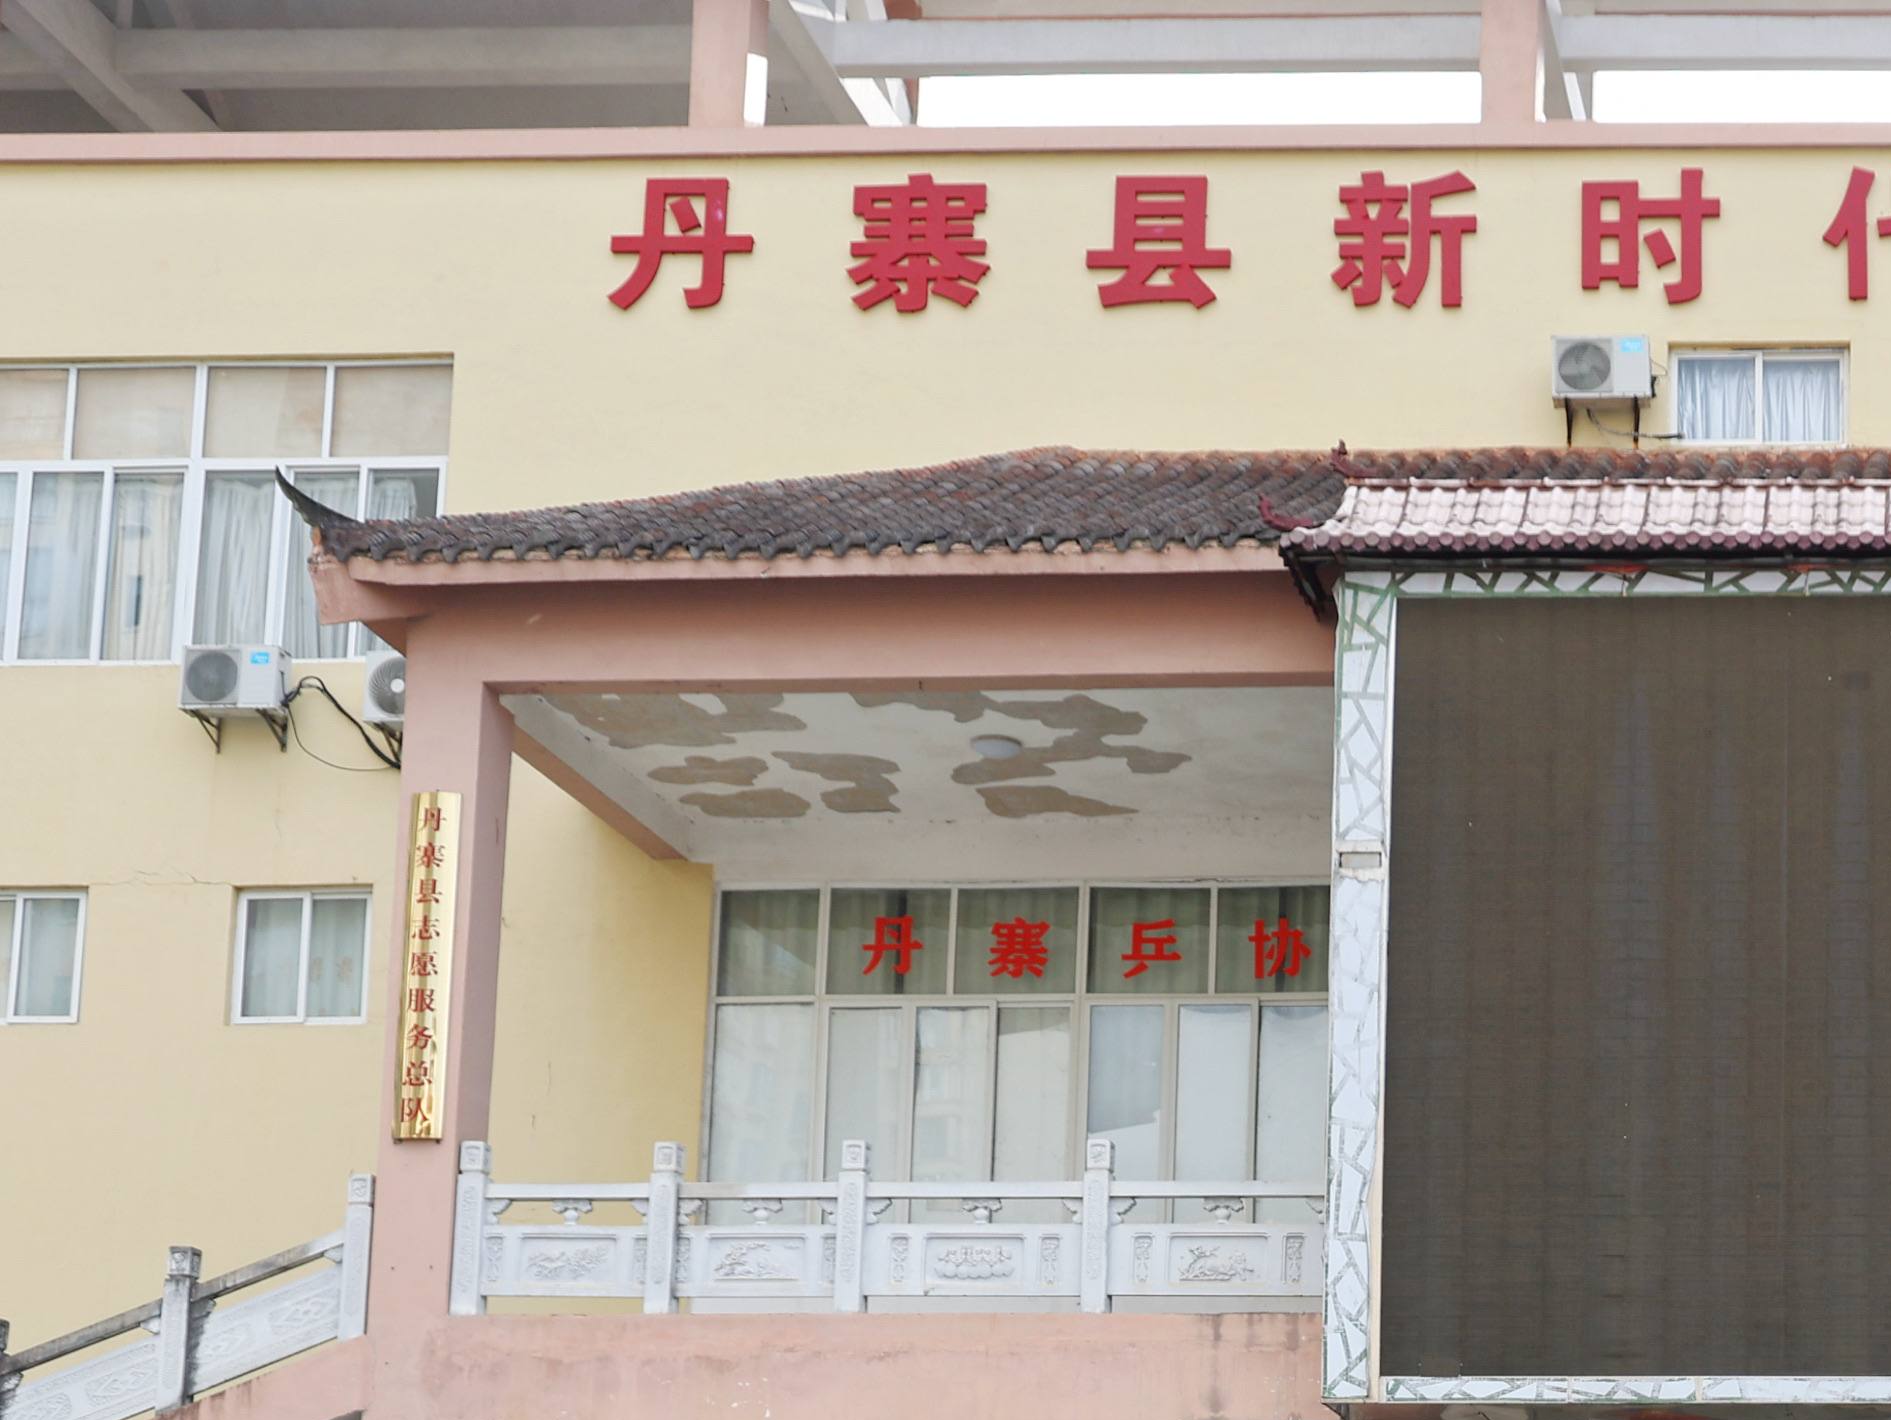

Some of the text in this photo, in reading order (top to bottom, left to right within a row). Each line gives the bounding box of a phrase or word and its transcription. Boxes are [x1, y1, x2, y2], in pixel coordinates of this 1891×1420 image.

[400, 806, 446, 1123] 丹寨县志愿服务总队
[862, 915, 1311, 979] 丹寨乒协
